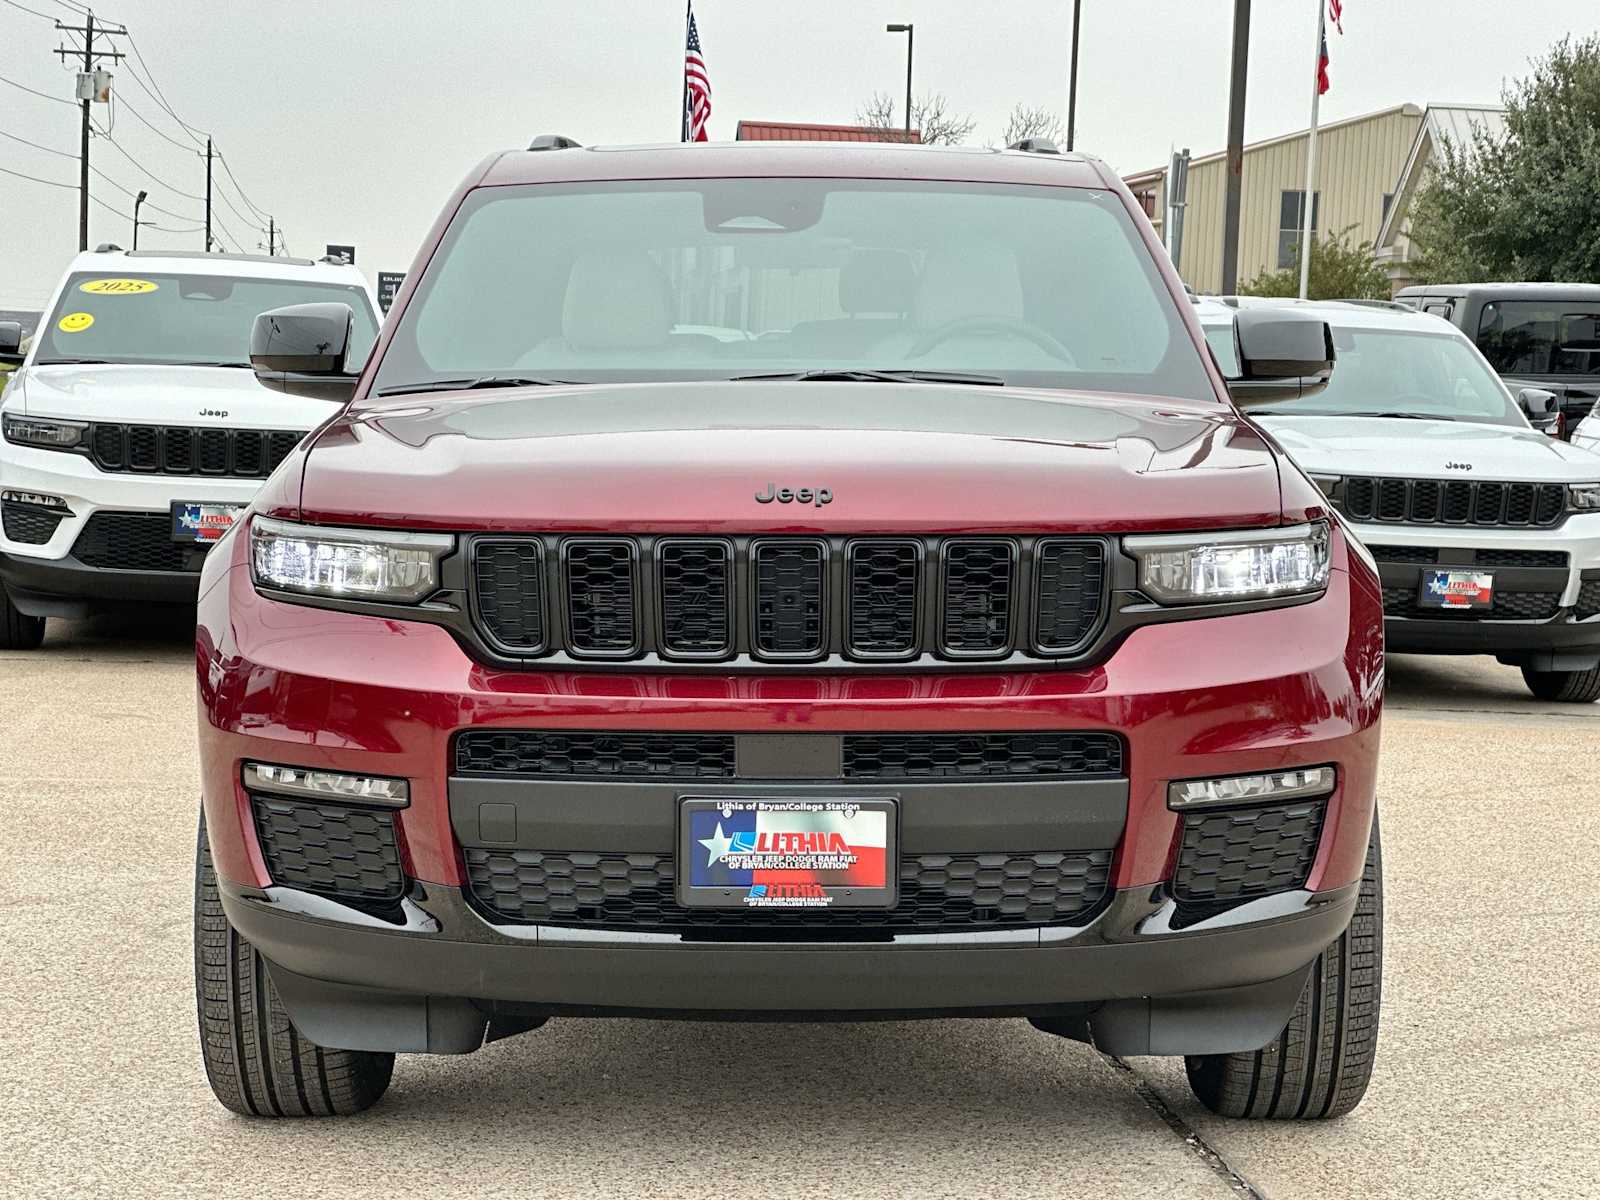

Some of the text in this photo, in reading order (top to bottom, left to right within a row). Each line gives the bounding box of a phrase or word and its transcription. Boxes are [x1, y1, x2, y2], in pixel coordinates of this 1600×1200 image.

[92, 282, 148, 292] 2025
[199, 408, 229, 418] Jeep
[1445, 461, 1472, 471] Jeep
[755, 483, 833, 507] Jeep
[201, 515, 234, 524] LITHIA
[716, 802, 860, 812] Lithia of Bryan/College Station
[756, 832, 850, 852] LITHIA
[719, 855, 858, 863] CHRYSLER JEEP DODGE RAM FIAT
[742, 862, 812, 870] BRYAN/COLLEGE
[767, 885, 827, 897] LITHIA
